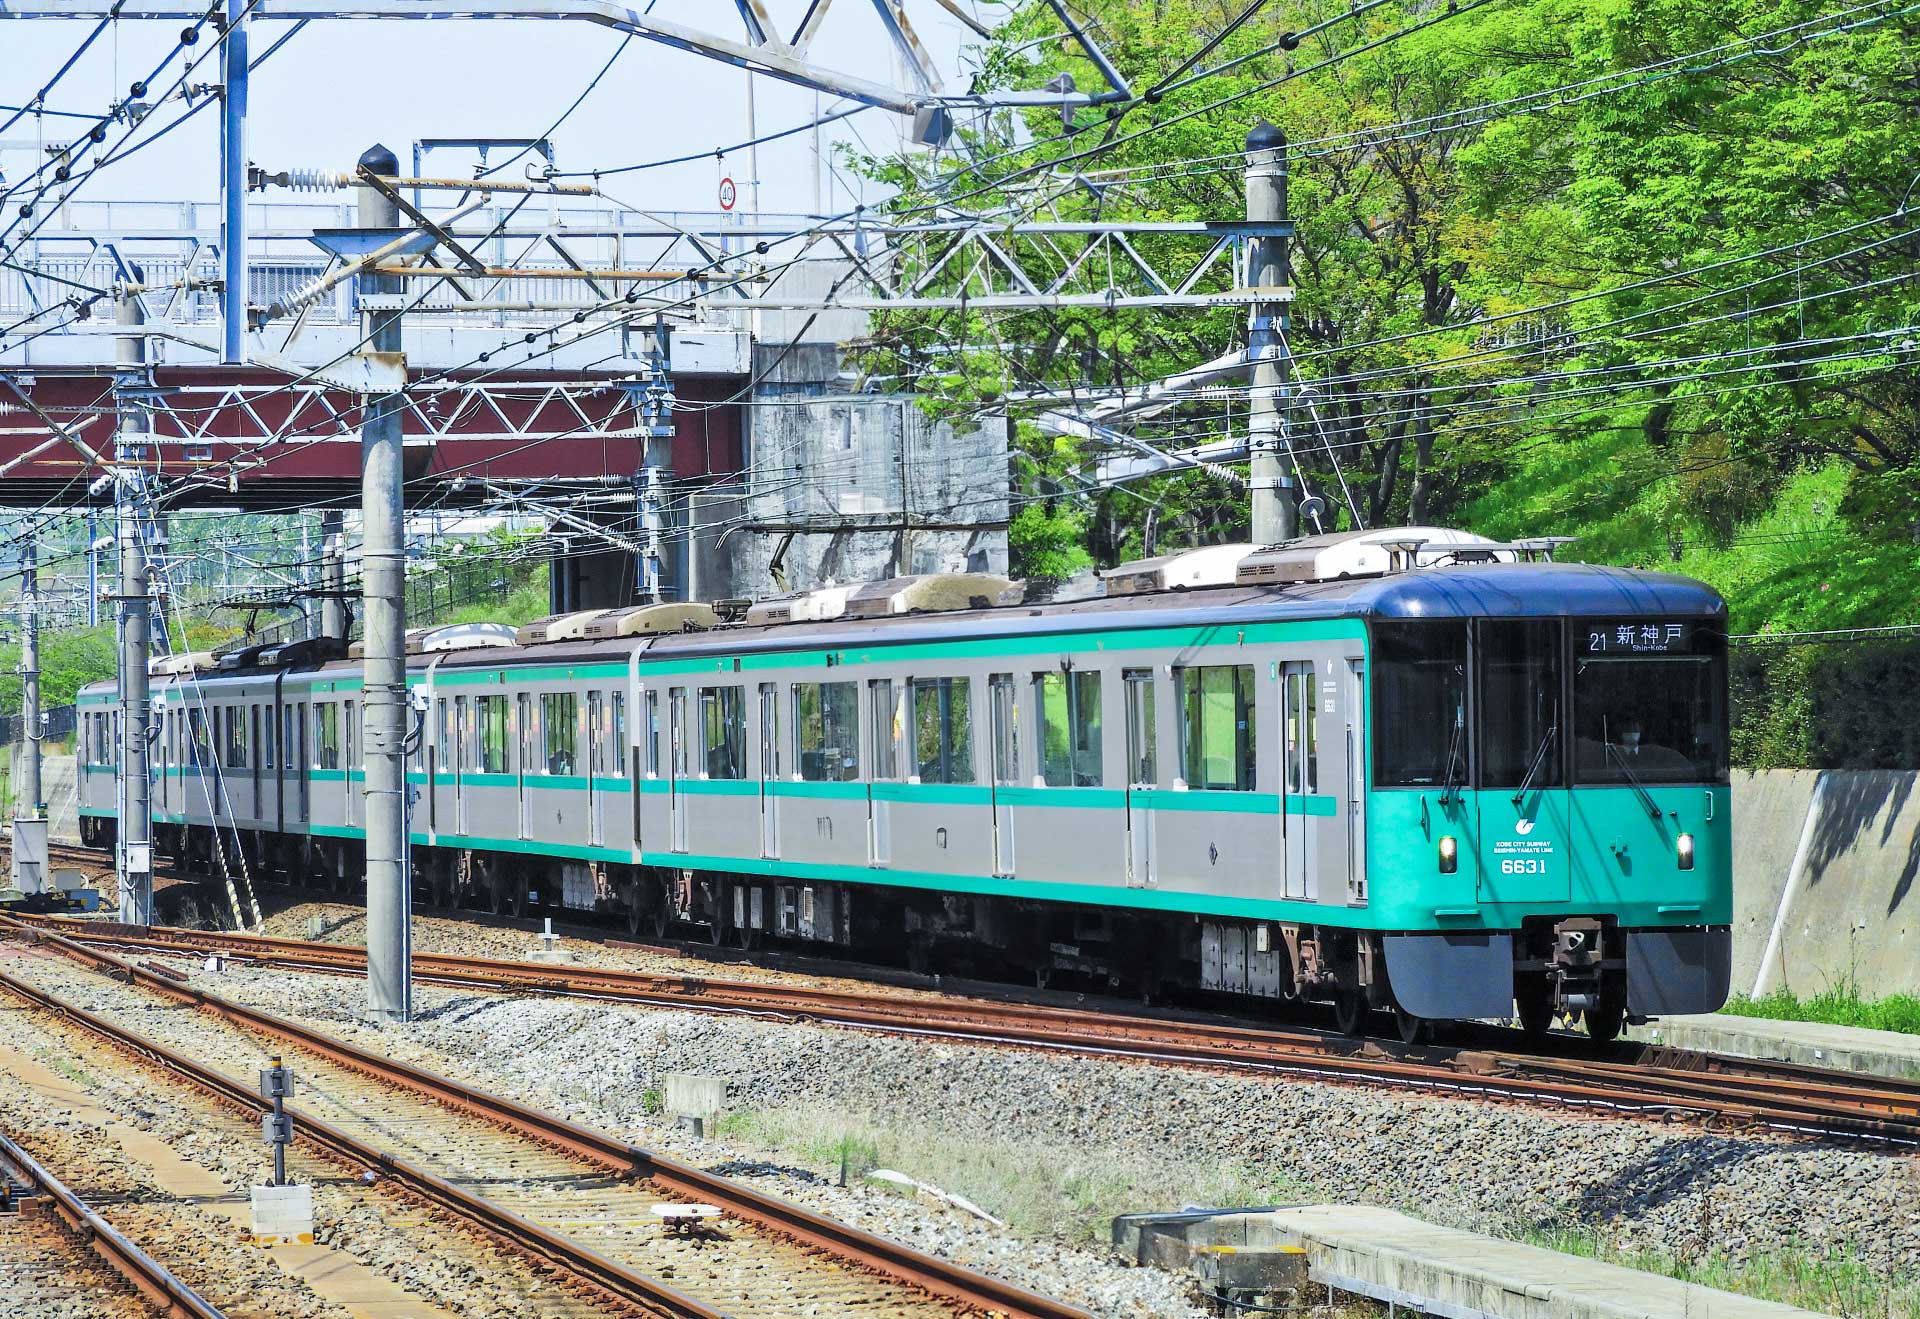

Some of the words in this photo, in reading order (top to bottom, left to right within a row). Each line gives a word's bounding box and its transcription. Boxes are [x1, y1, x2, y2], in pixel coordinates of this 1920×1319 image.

[722, 186, 732, 201] 40
[1590, 632, 1606, 651] 21
[1616, 624, 1683, 645] 新神戸
[1632, 644, 1668, 652] Shin-Kobe
[1501, 859, 1546, 874] 6631
